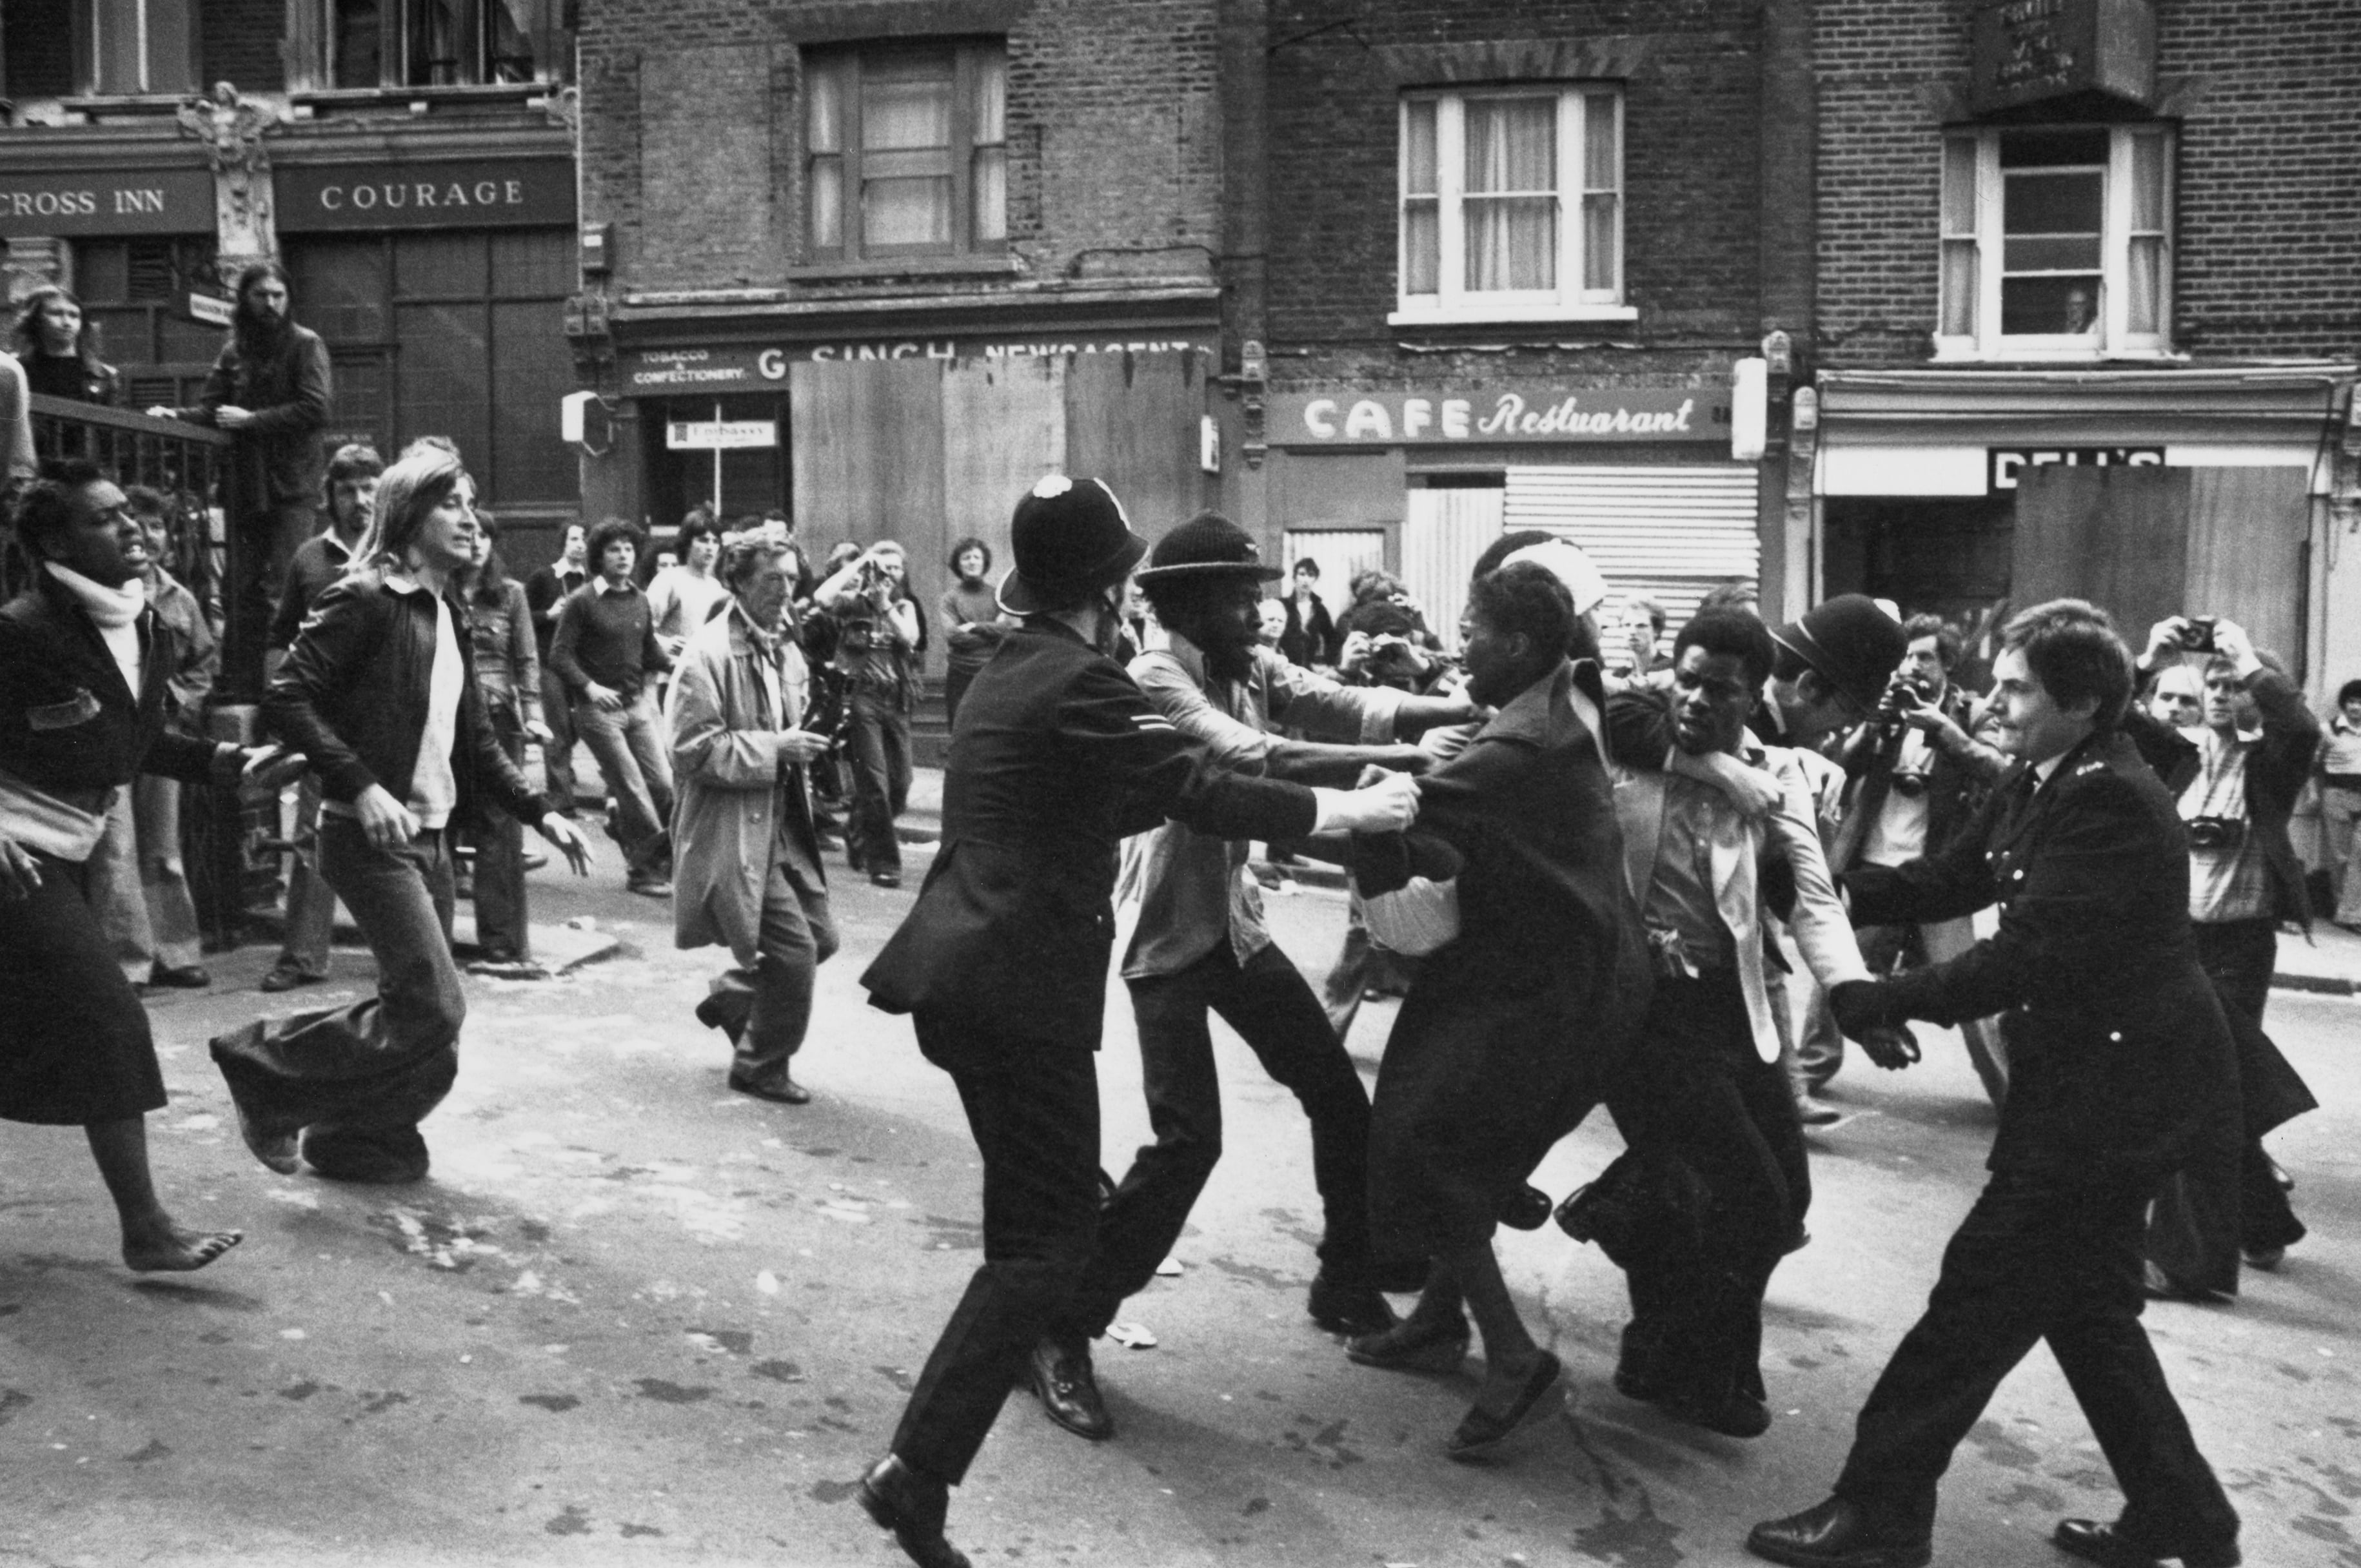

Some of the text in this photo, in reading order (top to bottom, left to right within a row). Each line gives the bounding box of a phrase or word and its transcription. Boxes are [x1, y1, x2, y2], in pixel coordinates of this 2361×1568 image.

[114, 190, 164, 213] INN
[321, 181, 524, 210] COURAGE
[641, 349, 709, 363] TOBACCO
[758, 348, 785, 380] G
[633, 368, 744, 384] CONFECTIONERY
[1304, 398, 1470, 439] CAFE
